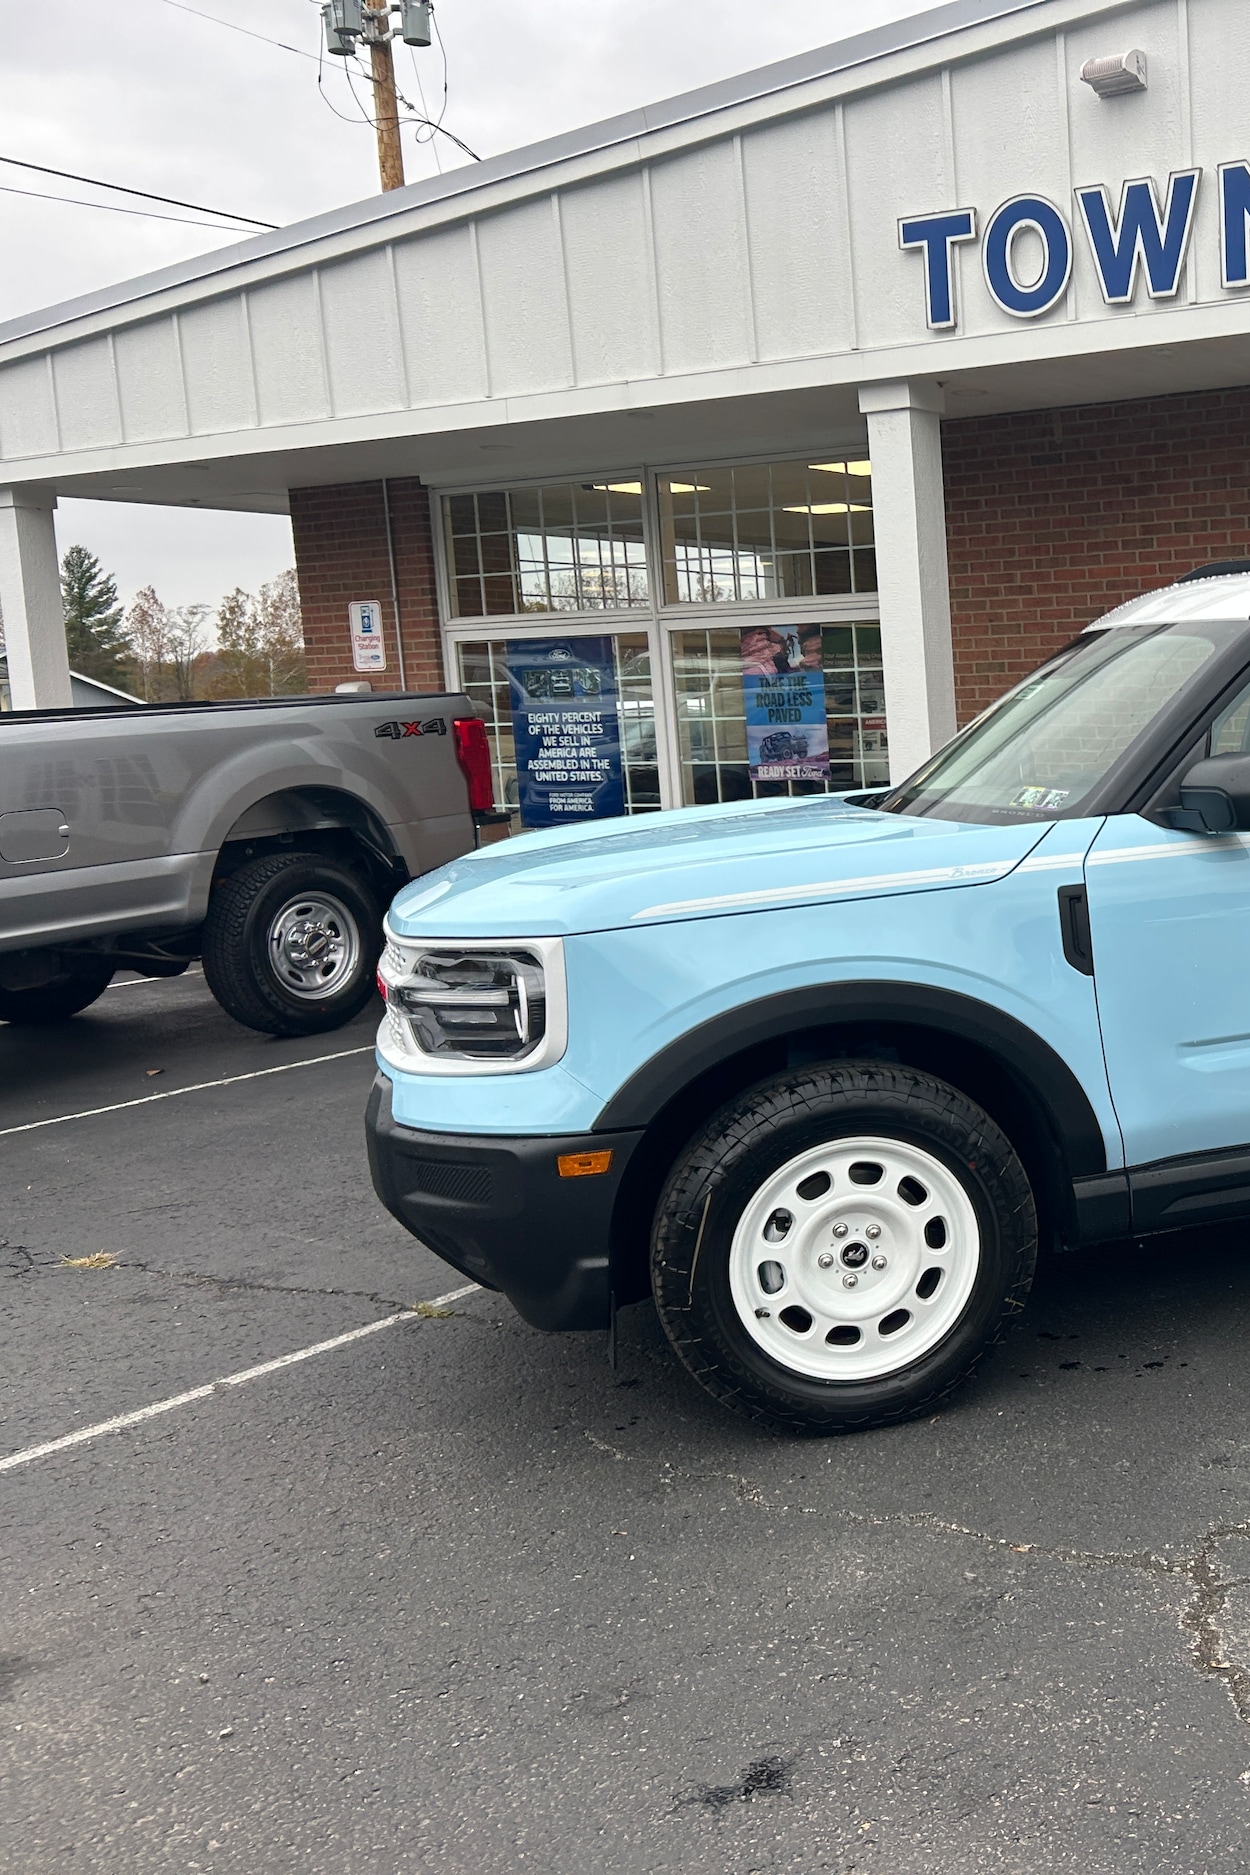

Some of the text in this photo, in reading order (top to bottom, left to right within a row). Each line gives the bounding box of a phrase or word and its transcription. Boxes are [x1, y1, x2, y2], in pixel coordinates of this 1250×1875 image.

[355, 635, 380, 643] Charging
[358, 643, 379, 651] Station
[550, 650, 568, 660] Ford
[759, 676, 807, 687] TAKE THE
[756, 691, 813, 708] ROAD LESS
[528, 712, 601, 723] EIGHTY PERCENT
[768, 708, 802, 723] PAVED
[528, 724, 603, 735] OF THE VEHICLES
[542, 736, 591, 746] WE SELL IN
[538, 747, 597, 758] AMERICA ARE
[528, 759, 610, 770] ASSEMBLED IN THE
[535, 771, 604, 781] UNITED STATES.
[757, 765, 824, 778] READY SET Ford
[948, 867, 998, 879] Bronco
